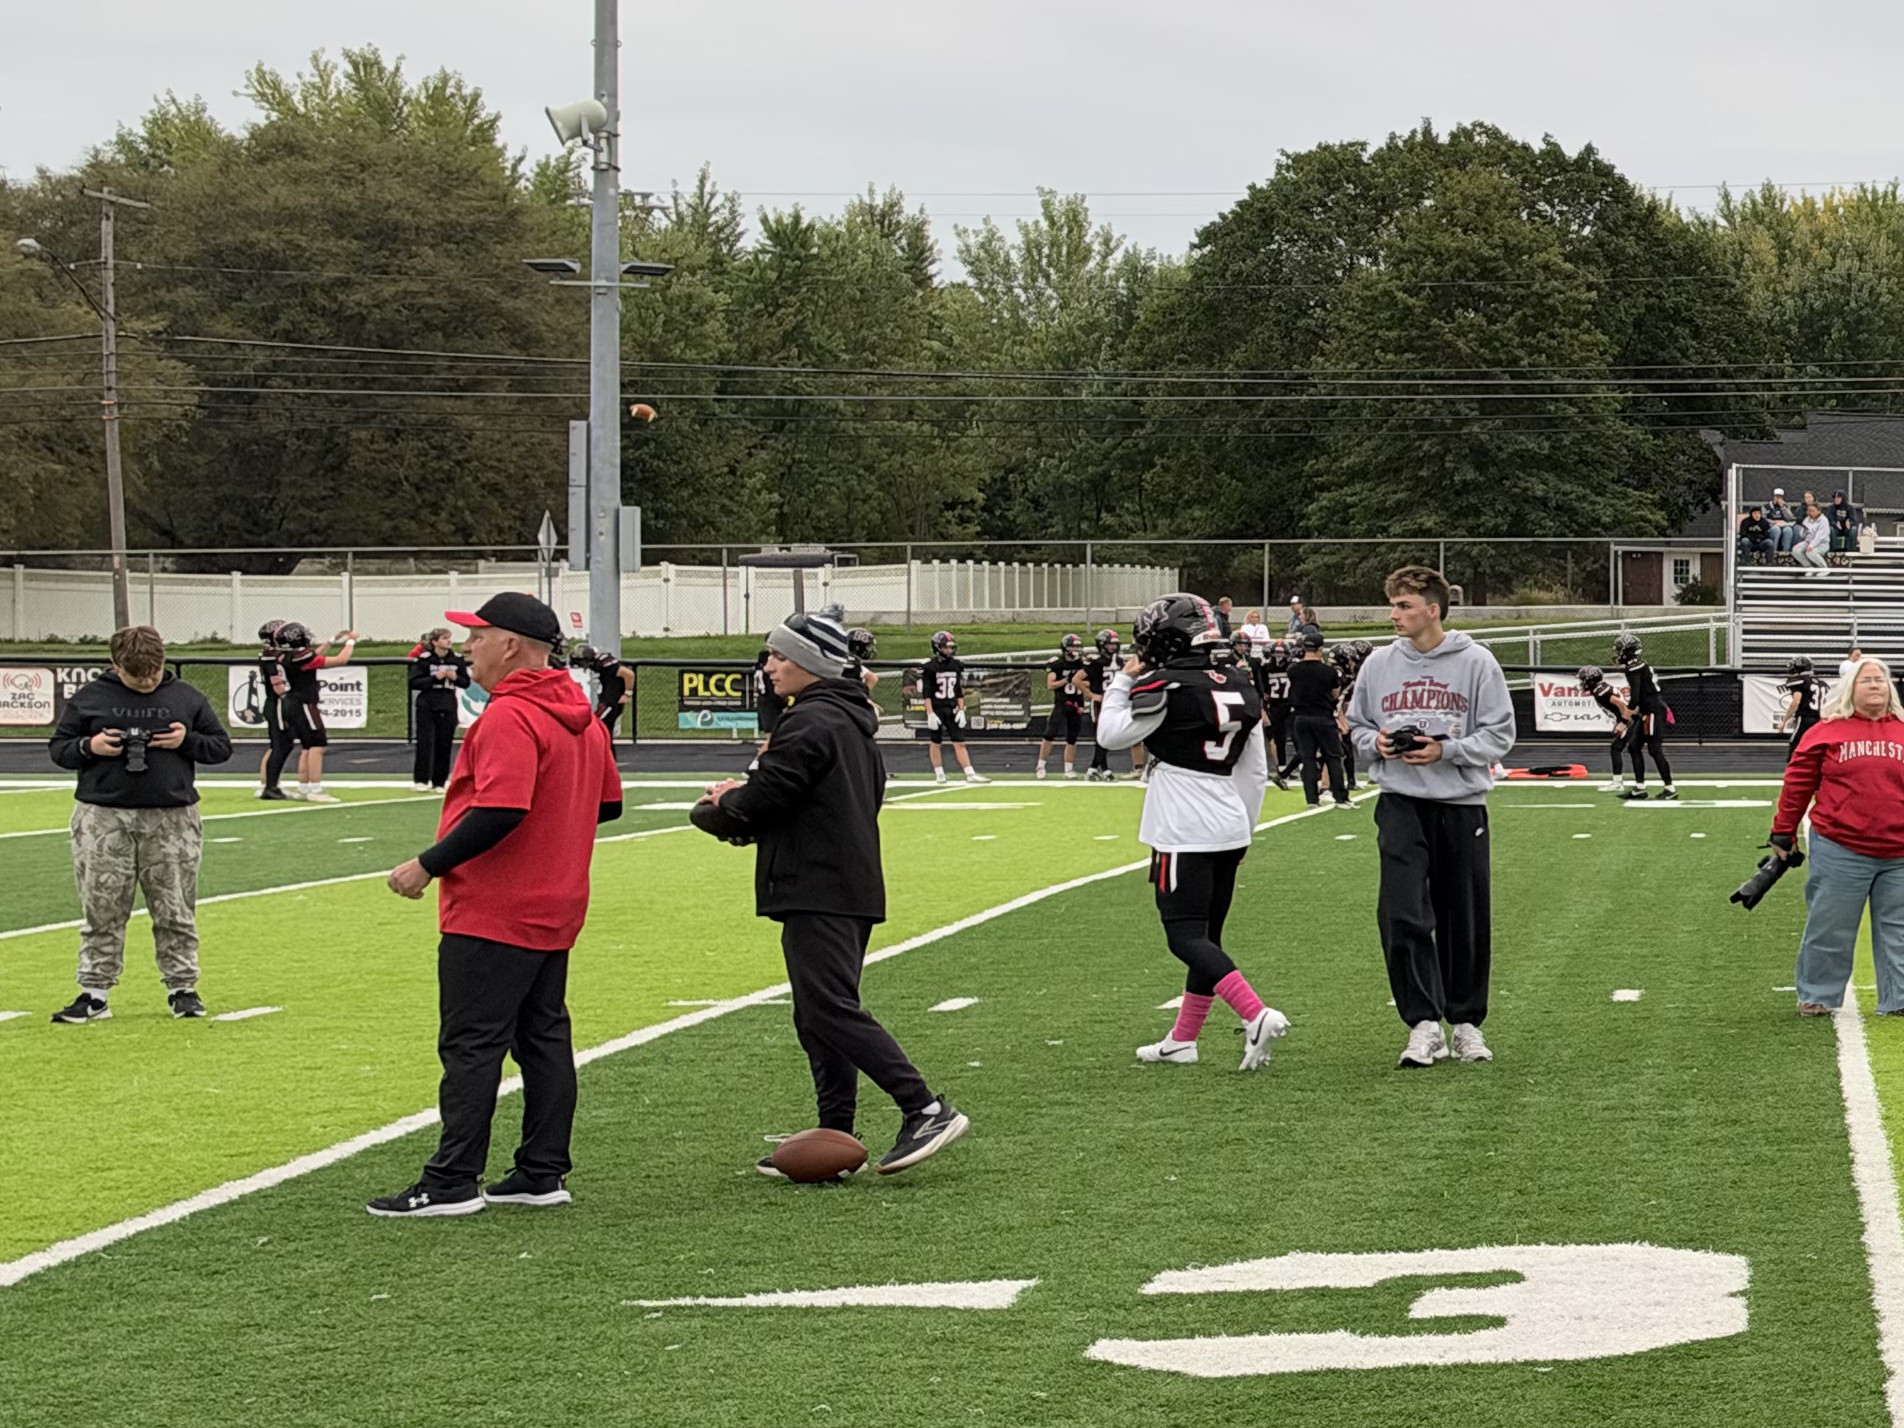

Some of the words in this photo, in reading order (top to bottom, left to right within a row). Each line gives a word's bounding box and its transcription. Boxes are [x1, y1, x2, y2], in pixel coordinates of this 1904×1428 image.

[11, 692, 35, 701] ZAC
[683, 673, 742, 697] PLCC
[1268, 677, 1291, 699] 27
[1381, 689, 1469, 714] CHAMPIONS
[1203, 690, 1245, 761] 5
